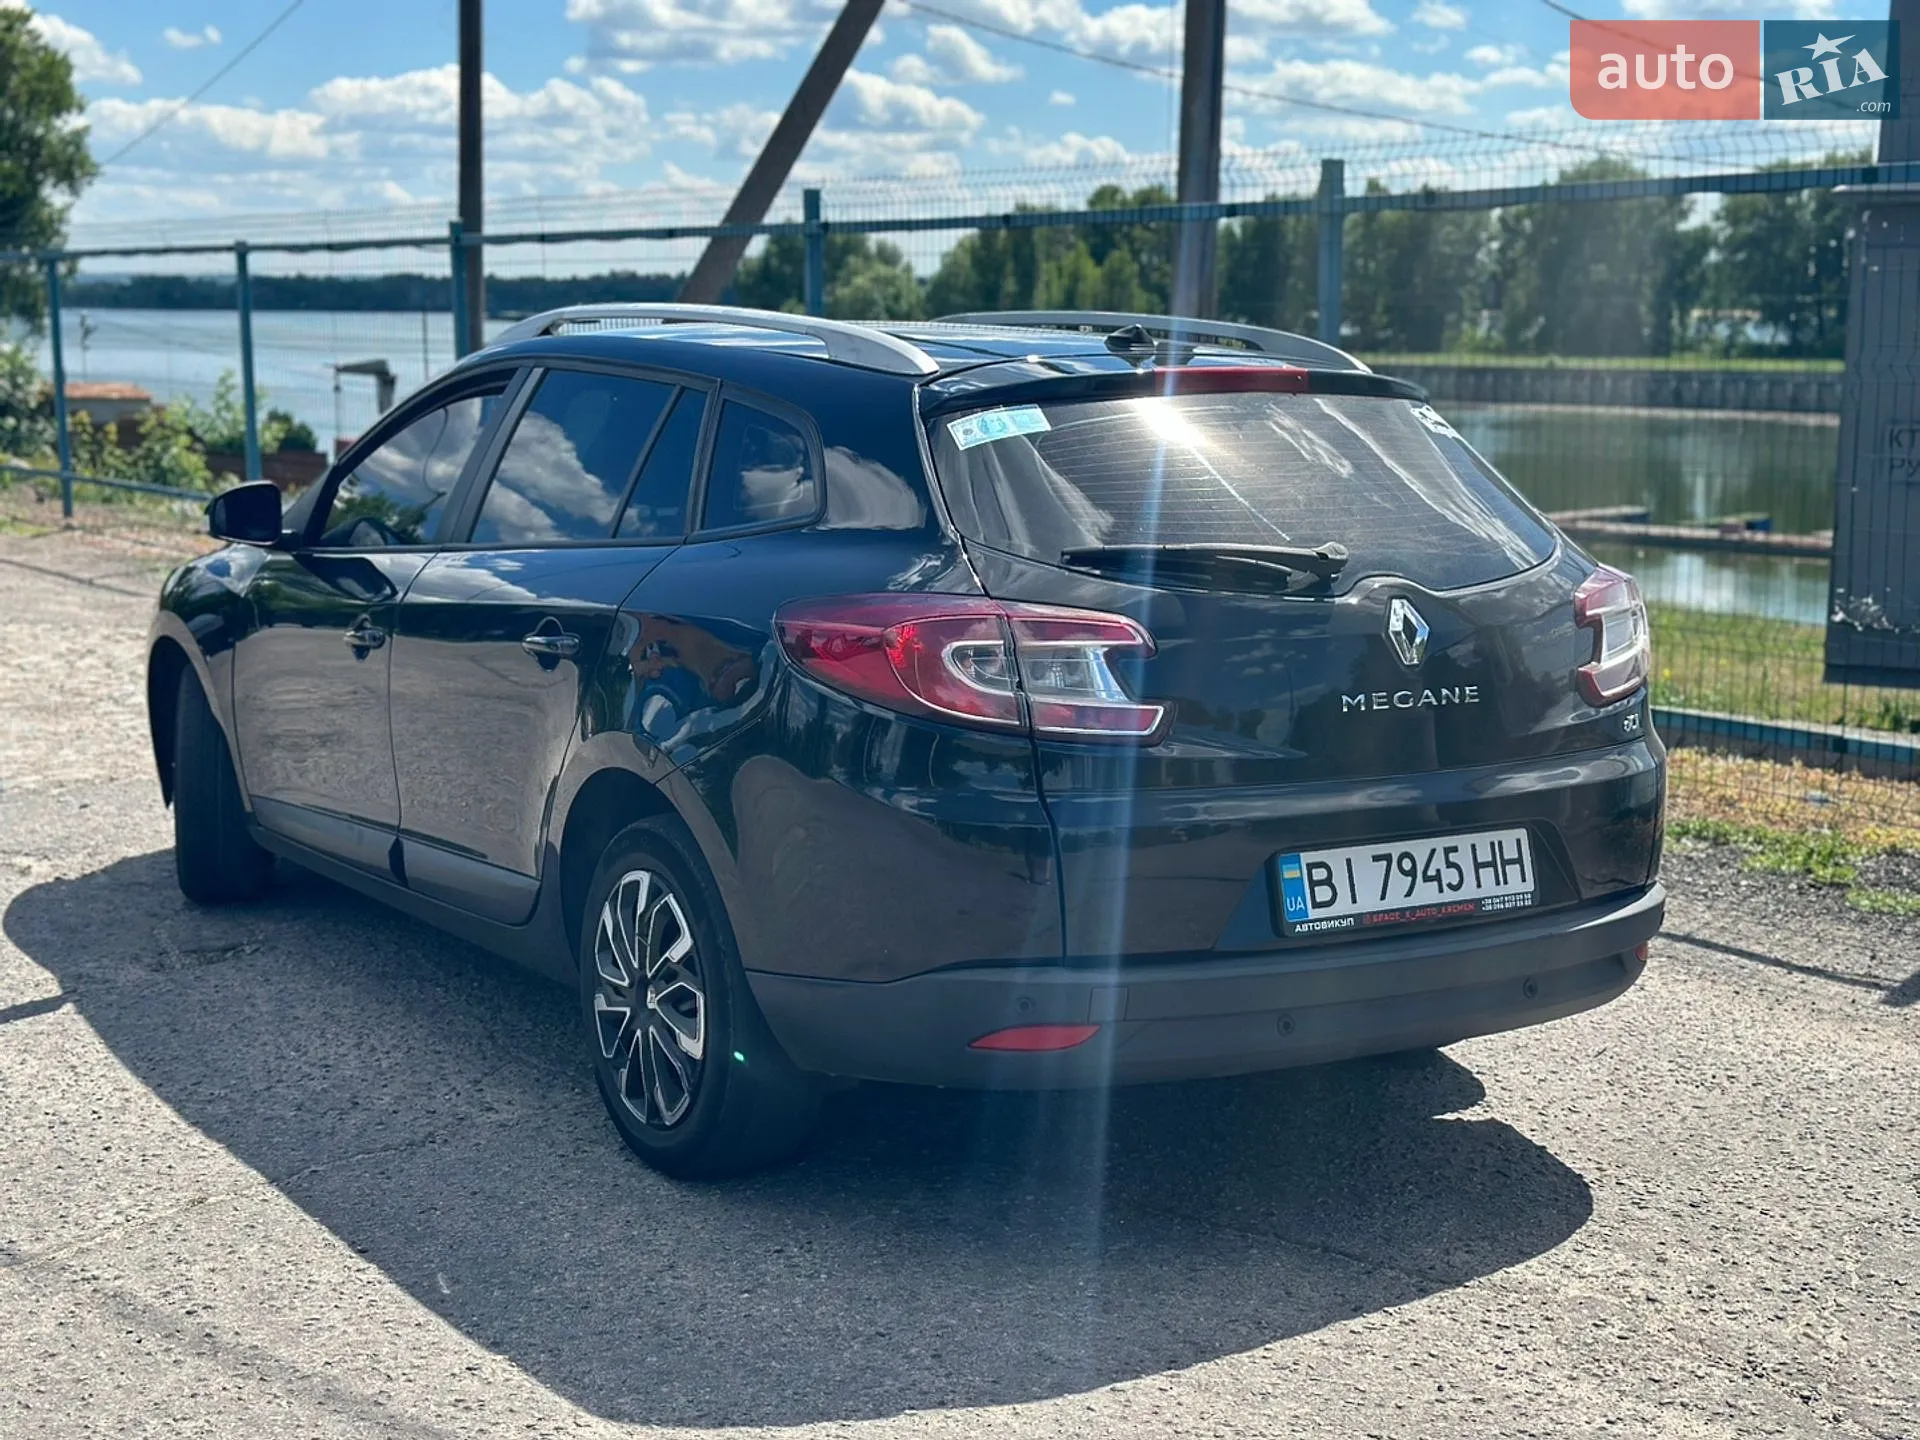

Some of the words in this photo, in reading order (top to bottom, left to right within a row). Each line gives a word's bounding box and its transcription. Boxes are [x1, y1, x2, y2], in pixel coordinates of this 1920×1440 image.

[1341, 685, 1481, 712] MEGANE
[1305, 860, 1358, 910] BI
[1371, 845, 1465, 901] 7945
[1470, 837, 1527, 889] HH
[1286, 896, 1306, 912] UA
[1294, 917, 1355, 932] АВТОВИКУП
